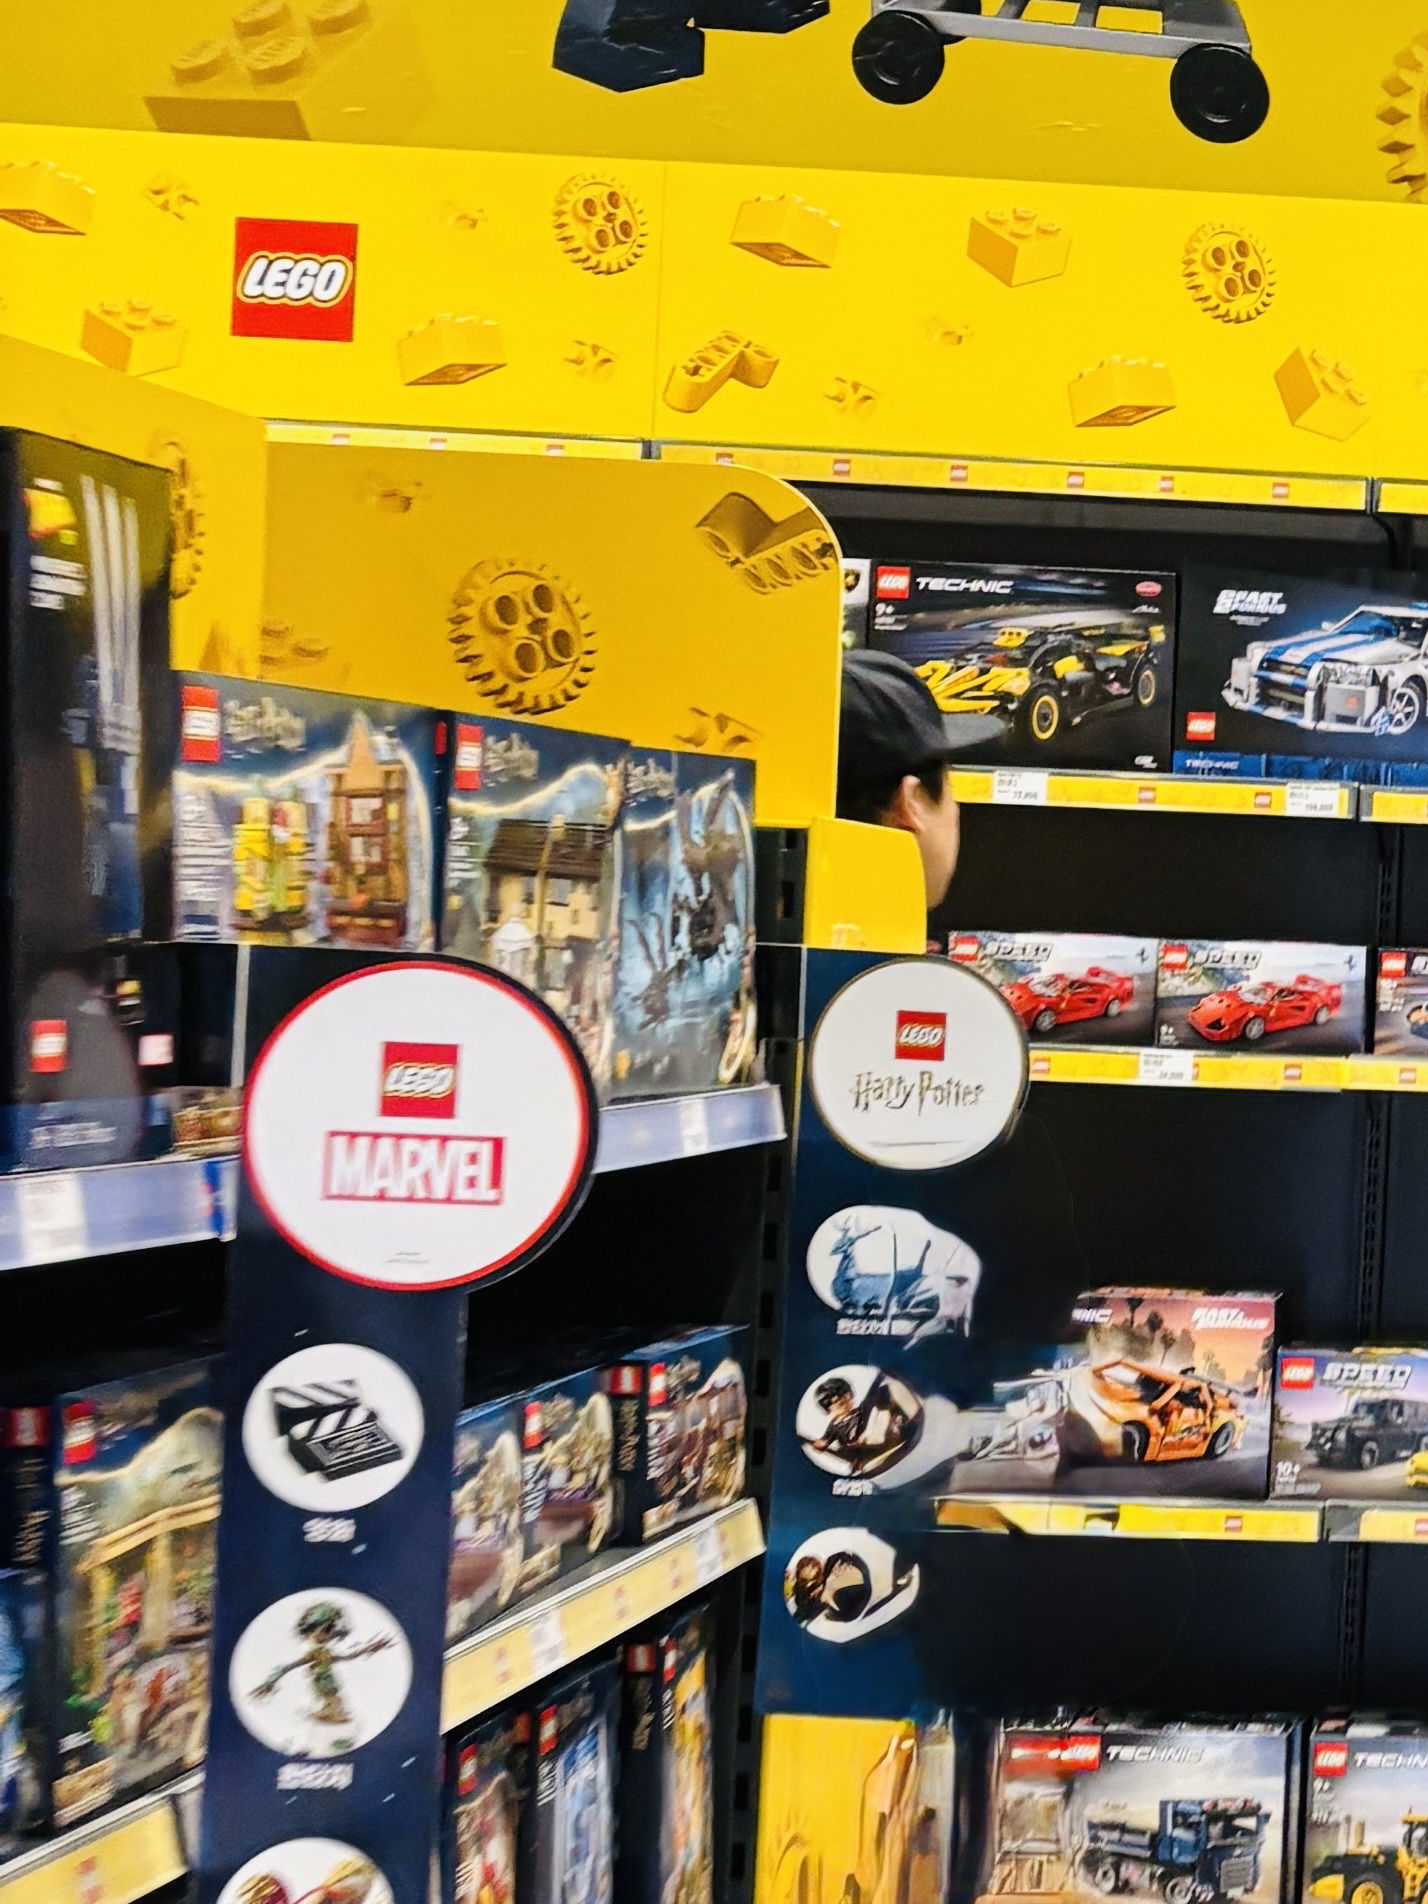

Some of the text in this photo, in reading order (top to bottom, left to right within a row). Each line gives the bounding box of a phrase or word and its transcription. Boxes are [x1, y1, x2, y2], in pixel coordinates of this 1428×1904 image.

[243, 256, 347, 302] LEGO
[916, 576, 1014, 594] TECHNIC
[900, 1024, 943, 1046] LEGO
[384, 1064, 455, 1097] LEGO
[851, 1070, 985, 1116] Harry Potter
[330, 1135, 500, 1199] MARVEL
